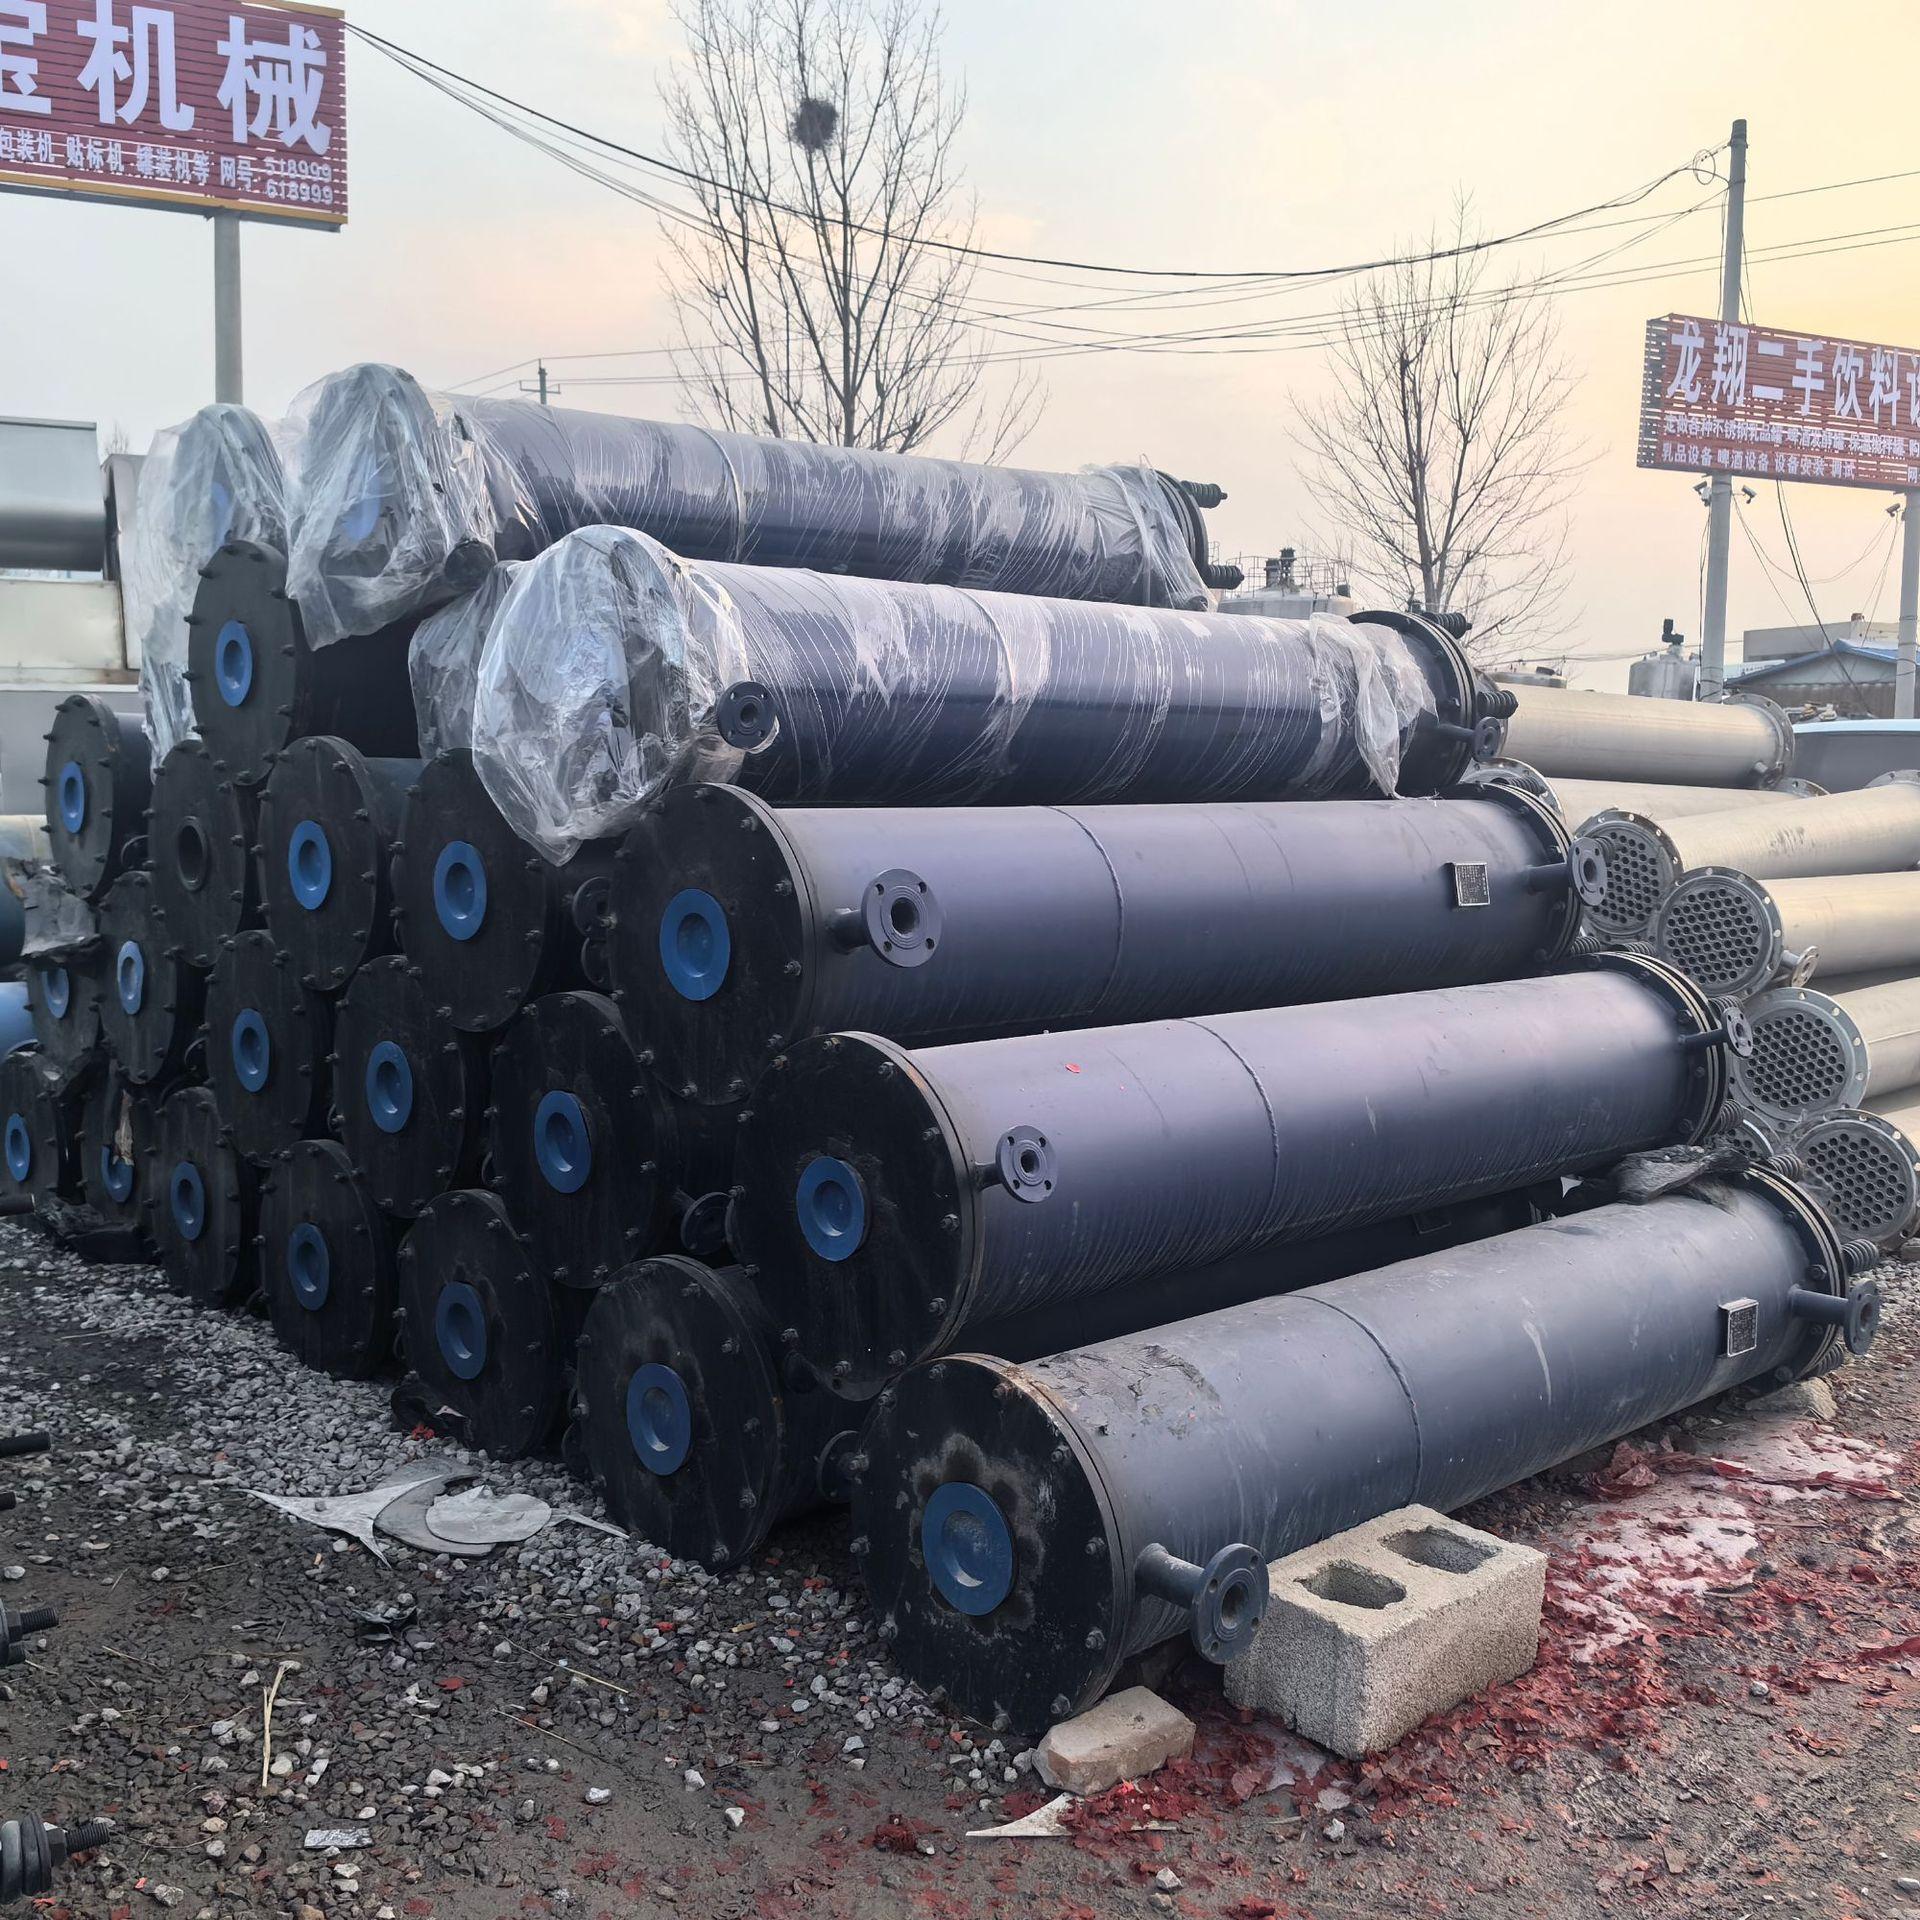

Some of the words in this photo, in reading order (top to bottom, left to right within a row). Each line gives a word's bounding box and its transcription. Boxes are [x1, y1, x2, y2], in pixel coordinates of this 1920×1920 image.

[66, 136, 125, 173] 贴标机
[263, 157, 332, 182] 518999
[266, 179, 333, 204] 618999
[1662, 442, 1712, 466] 乳品设备
[1717, 448, 1770, 472] 啤酒设备
[1774, 451, 1825, 477] 设备安装
